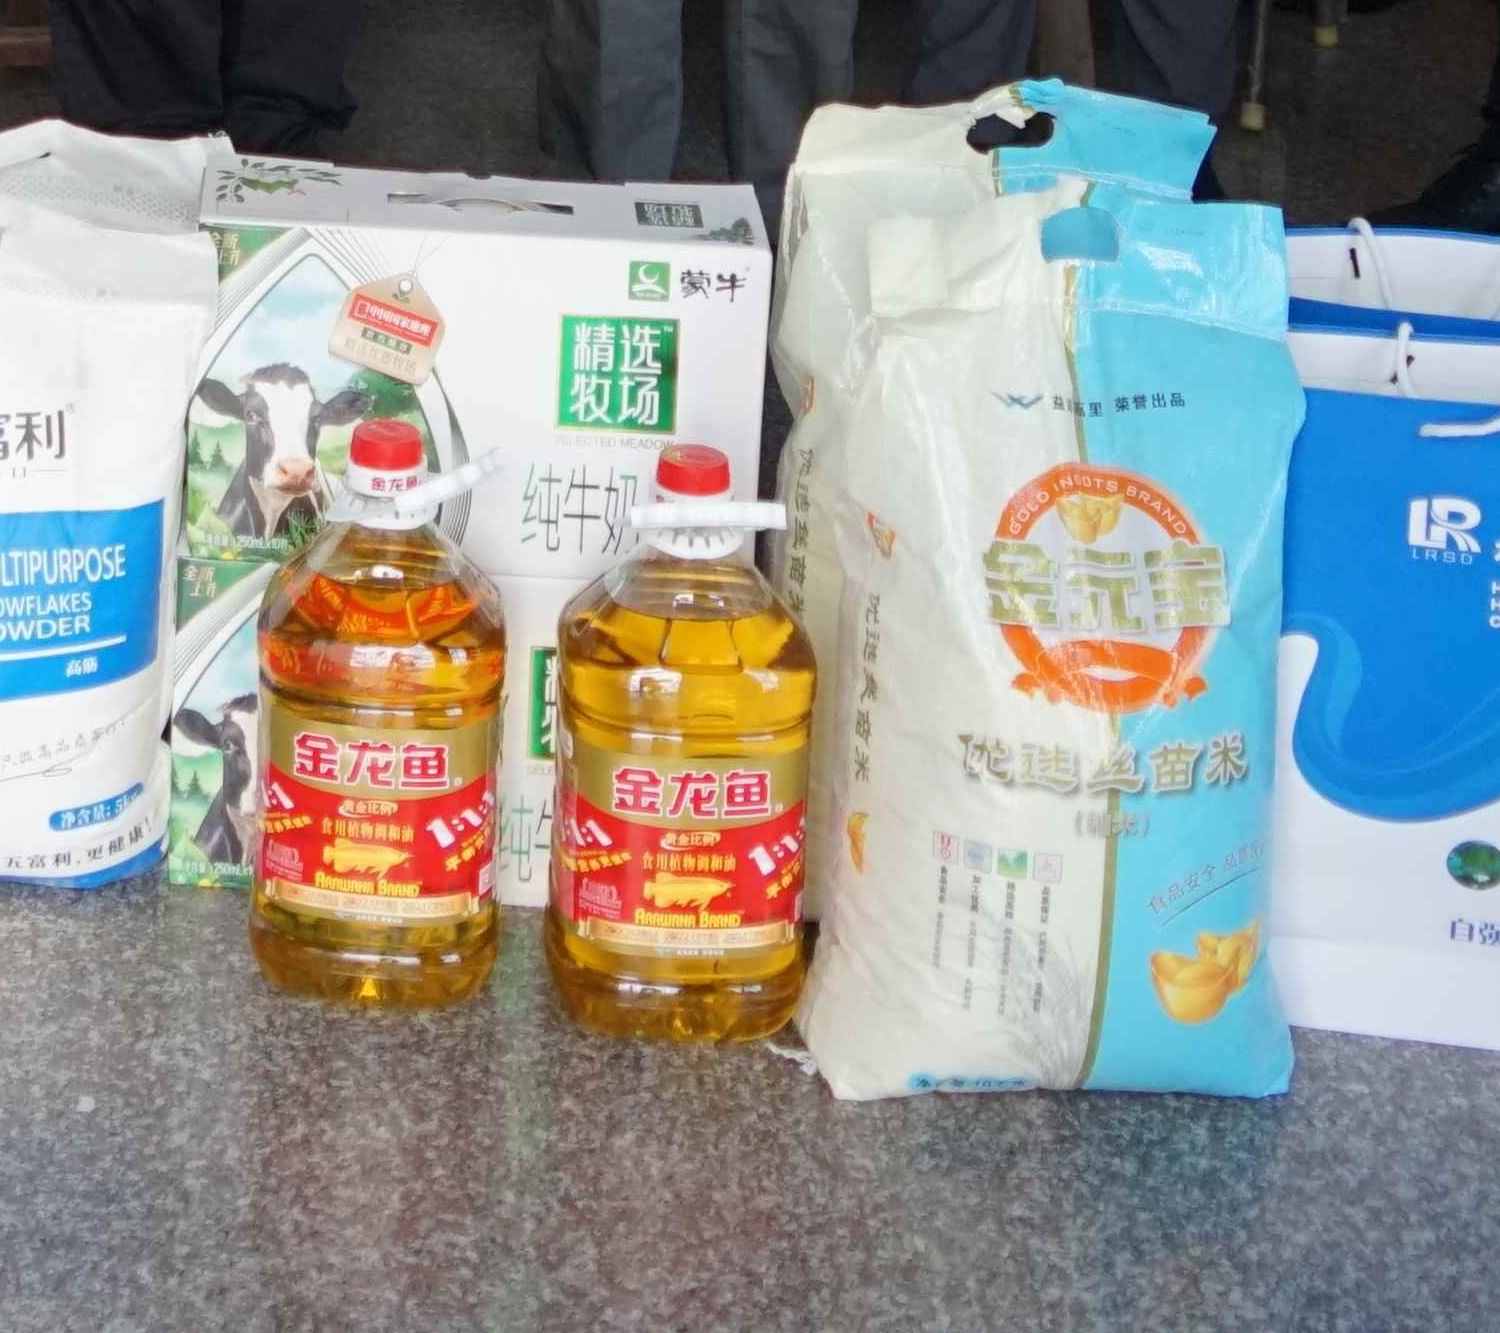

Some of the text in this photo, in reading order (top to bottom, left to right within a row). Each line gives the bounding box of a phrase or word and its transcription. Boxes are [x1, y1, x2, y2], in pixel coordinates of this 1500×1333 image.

[680, 268, 748, 303] 蒙牛
[573, 322, 664, 374] 精选
[569, 375, 661, 429] 牧场
[1114, 391, 1186, 414] 荣誉出品
[520, 462, 641, 557] 纯牛奶
[1009, 490, 1050, 536] GOLD
[1126, 483, 1188, 535] BRAND
[1412, 548, 1474, 566] LRSD
[983, 536, 1233, 633] 金元宝
[293, 731, 452, 791] 金龙鱼
[957, 731, 1250, 796] 优选丝苗米
[612, 764, 774, 820] 金龙鱼
[321, 816, 415, 843] 食用植物调和油
[377, 877, 421, 898] BRAND
[641, 851, 737, 872] 食用植物调和油
[699, 908, 742, 930] BRAND
